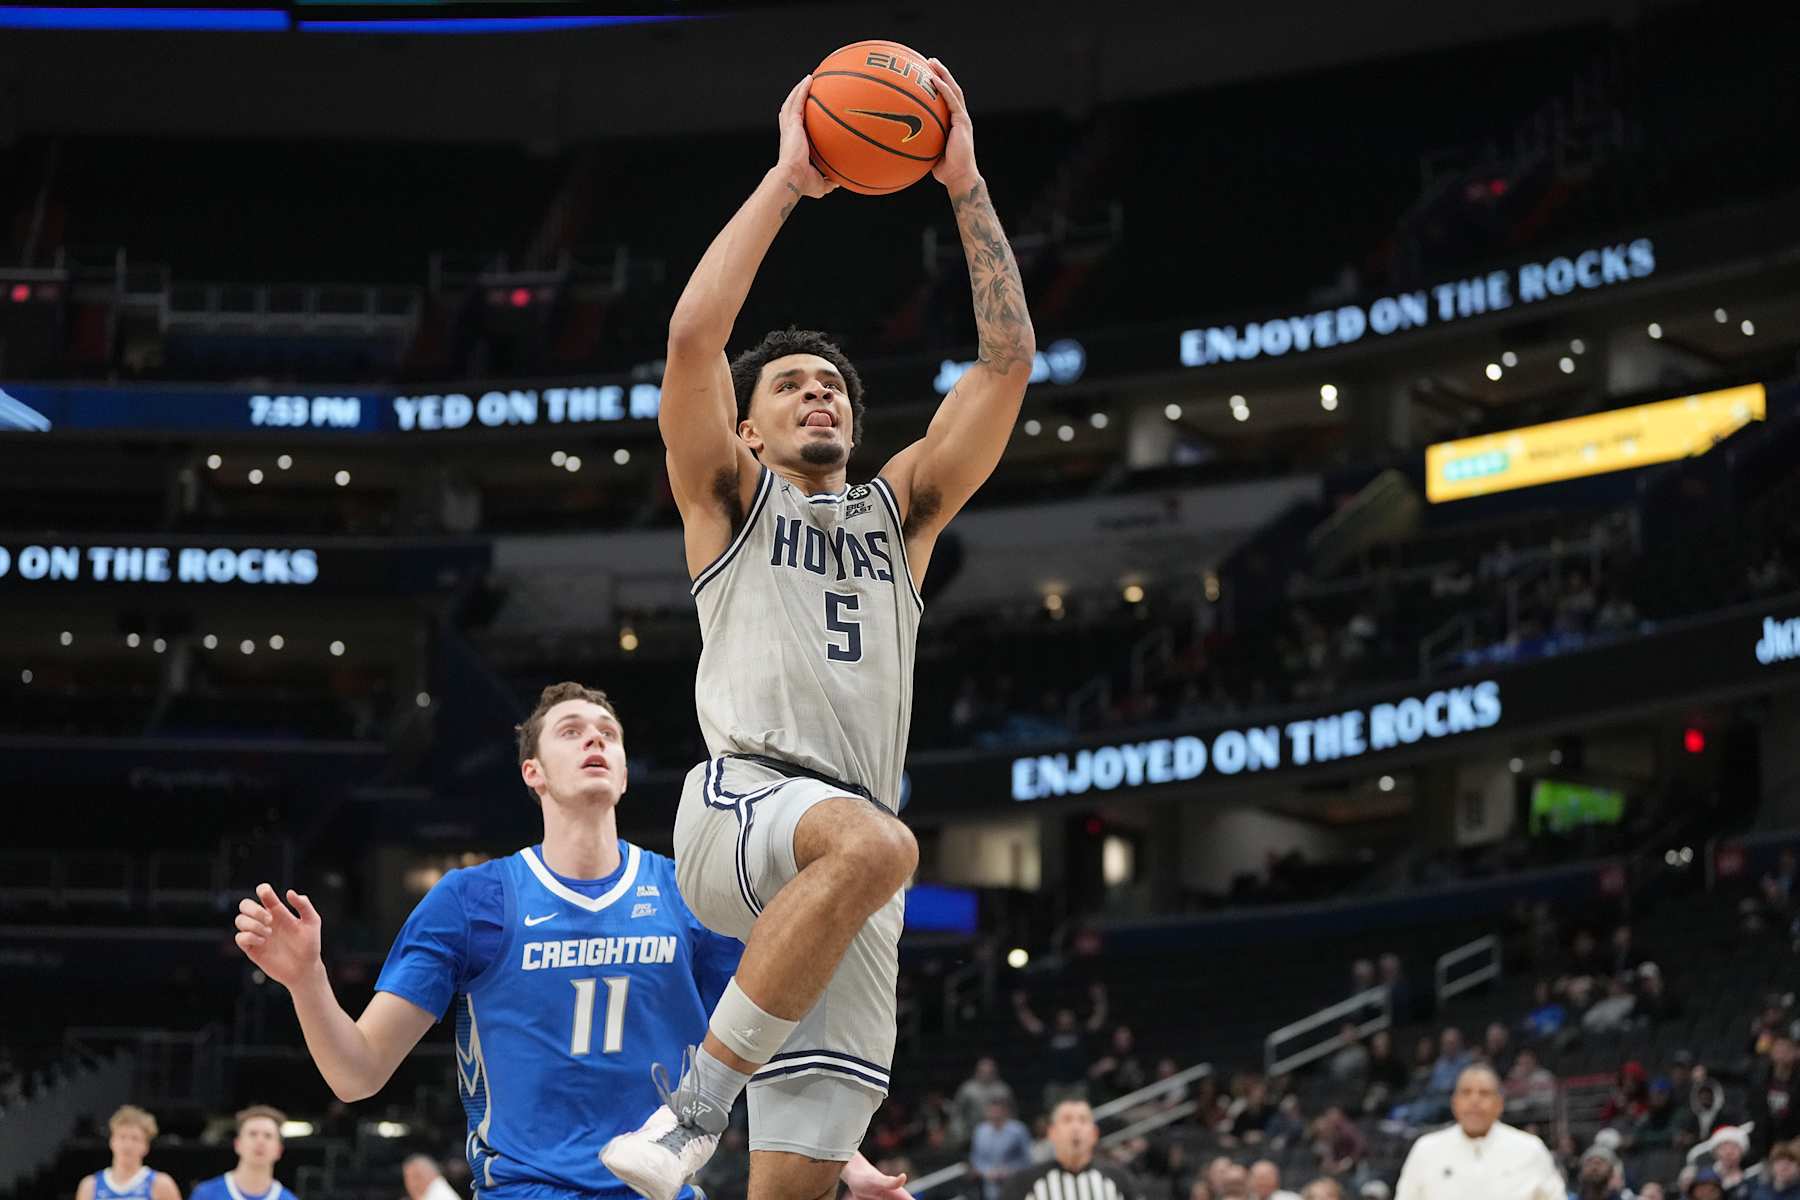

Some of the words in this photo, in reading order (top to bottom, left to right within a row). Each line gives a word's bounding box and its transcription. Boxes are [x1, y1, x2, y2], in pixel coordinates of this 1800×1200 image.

[1179, 304, 1367, 367] ENJOYED
[1368, 289, 1428, 335] ON
[1433, 269, 1513, 321] THE
[1519, 238, 1655, 302] ROCKS
[310, 396, 361, 428] PM
[476, 390, 538, 427] ON
[543, 385, 625, 423] THE
[846, 504, 873, 519] EAST
[847, 501, 865, 510] BIG
[18, 545, 80, 580] ON
[88, 546, 170, 582] THE
[178, 548, 318, 584] ROCKS
[770, 514, 895, 584] HOYAS
[823, 590, 863, 664] 5
[1011, 735, 1207, 801] ENJOYED
[1211, 725, 1280, 774] ON
[1285, 709, 1367, 766] THE
[1370, 680, 1501, 751] ROCKS
[521, 936, 677, 970] CREIGHTON
[569, 976, 630, 1057] 11
